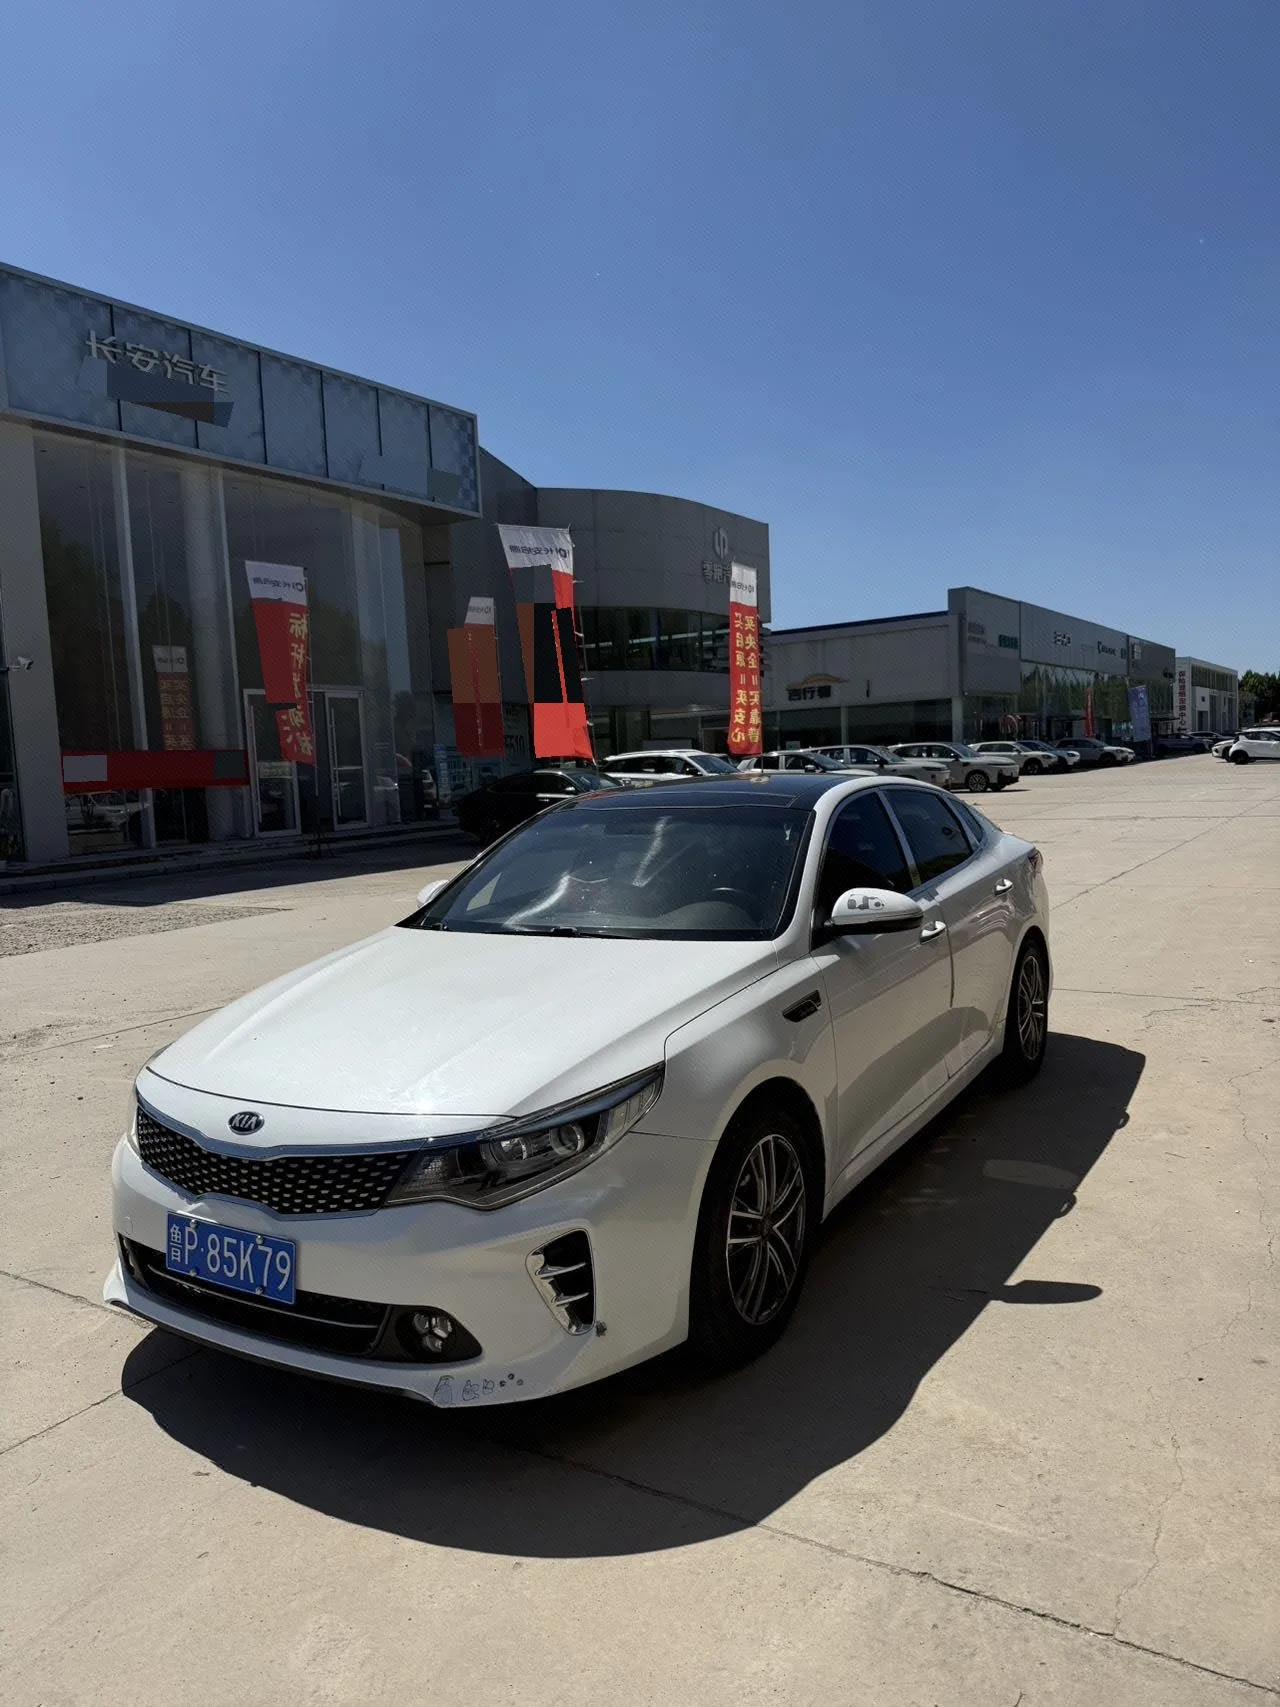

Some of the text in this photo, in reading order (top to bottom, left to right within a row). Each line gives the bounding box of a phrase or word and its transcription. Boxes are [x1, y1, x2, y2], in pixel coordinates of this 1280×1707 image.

[85, 329, 229, 393] 长安汽车
[230, 1113, 258, 1129] KIA
